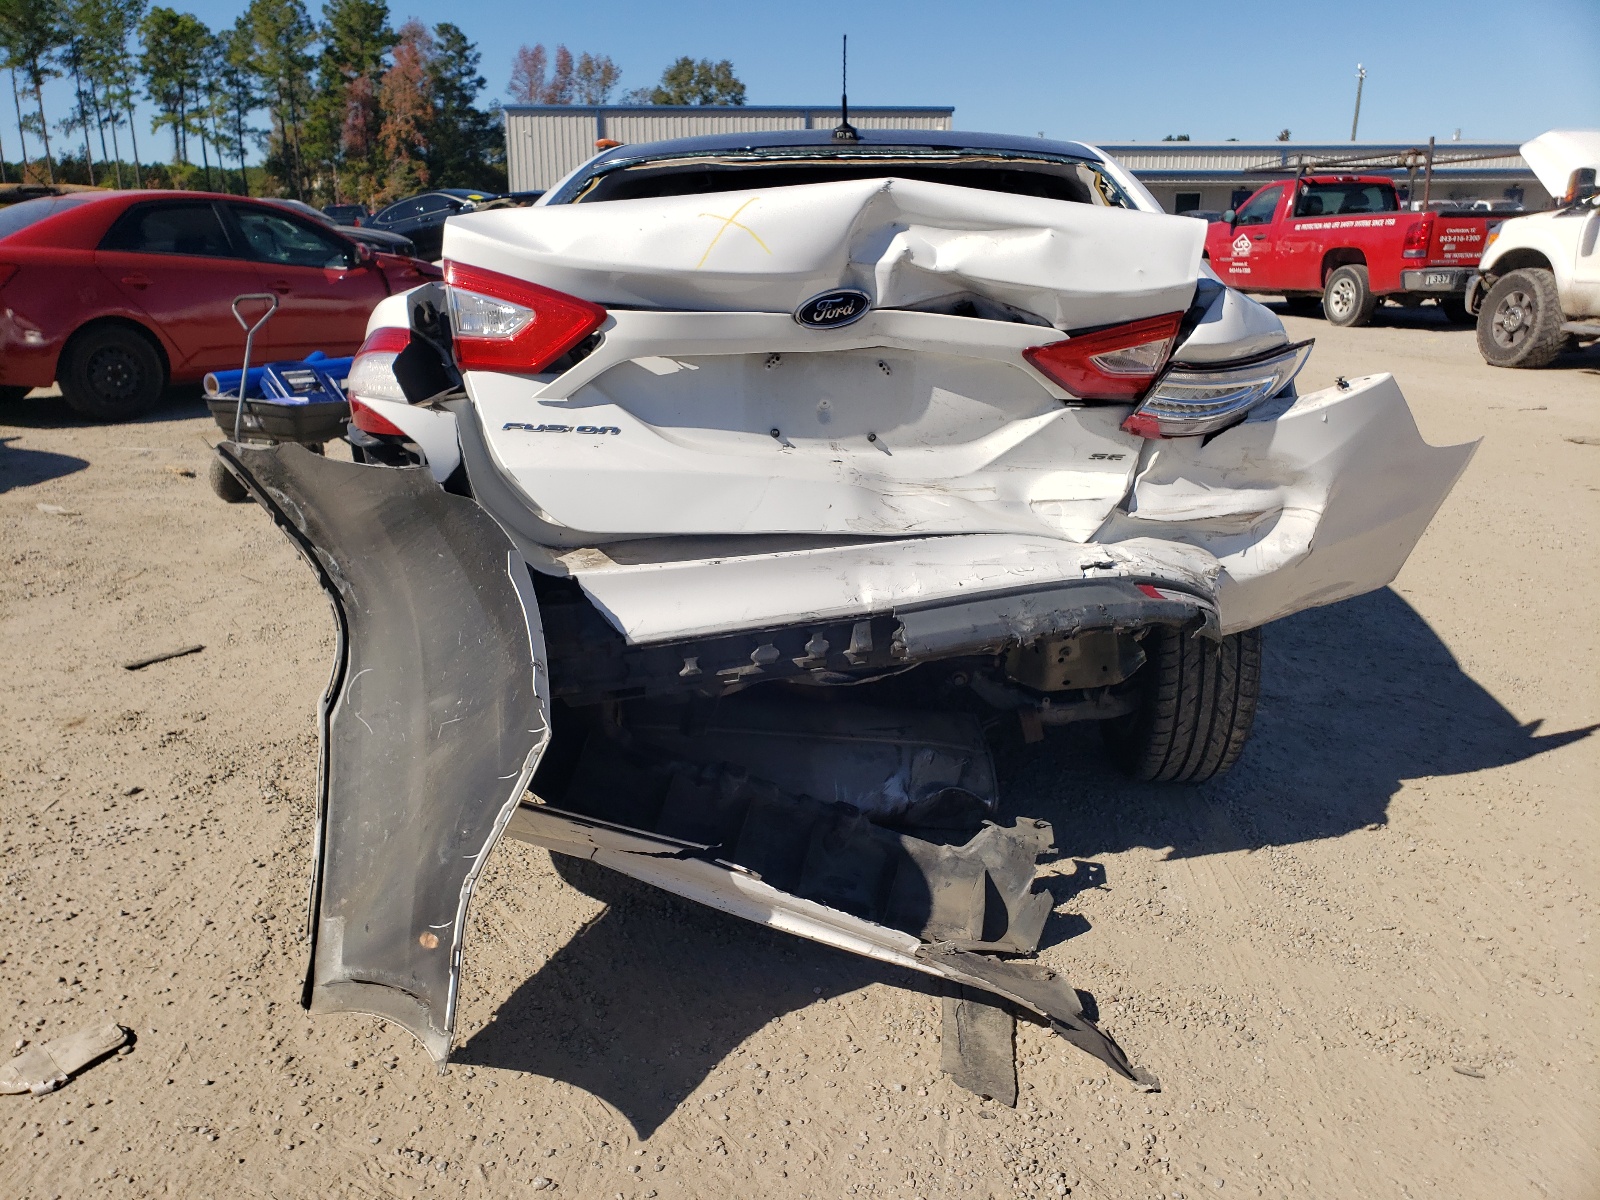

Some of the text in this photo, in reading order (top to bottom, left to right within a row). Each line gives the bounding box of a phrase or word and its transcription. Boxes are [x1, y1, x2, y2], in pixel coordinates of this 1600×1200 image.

[1439, 234, 1481, 243] 843-416-1300
[813, 297, 855, 322] Ford
[502, 422, 622, 436] FUSION
[1088, 453, 1126, 461] SE
